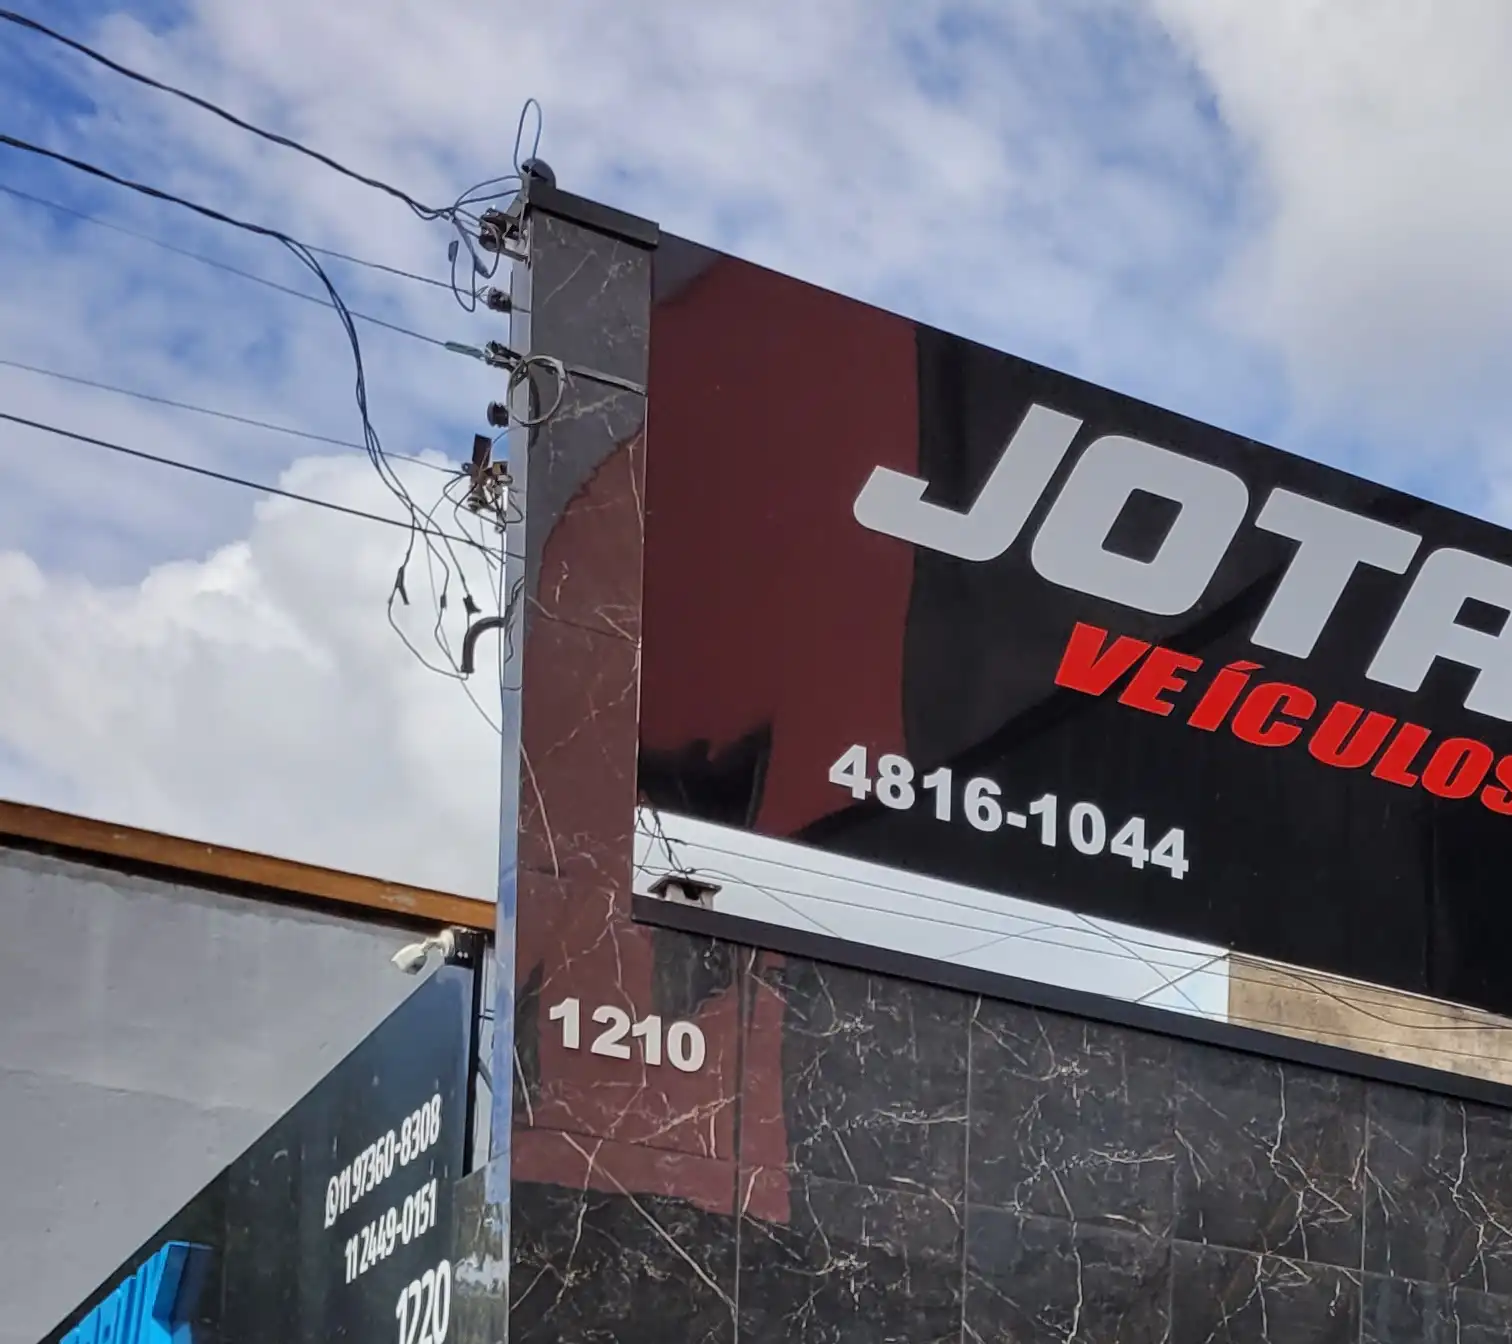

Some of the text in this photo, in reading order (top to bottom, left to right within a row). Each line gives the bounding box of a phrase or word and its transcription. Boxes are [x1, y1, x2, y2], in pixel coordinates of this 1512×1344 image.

[828, 744, 1190, 880] 4816-1044
[548, 997, 706, 1072] 1210
[338, 1093, 442, 1215] 11 97360-8308
[345, 1178, 437, 1284] 11 2449-0151
